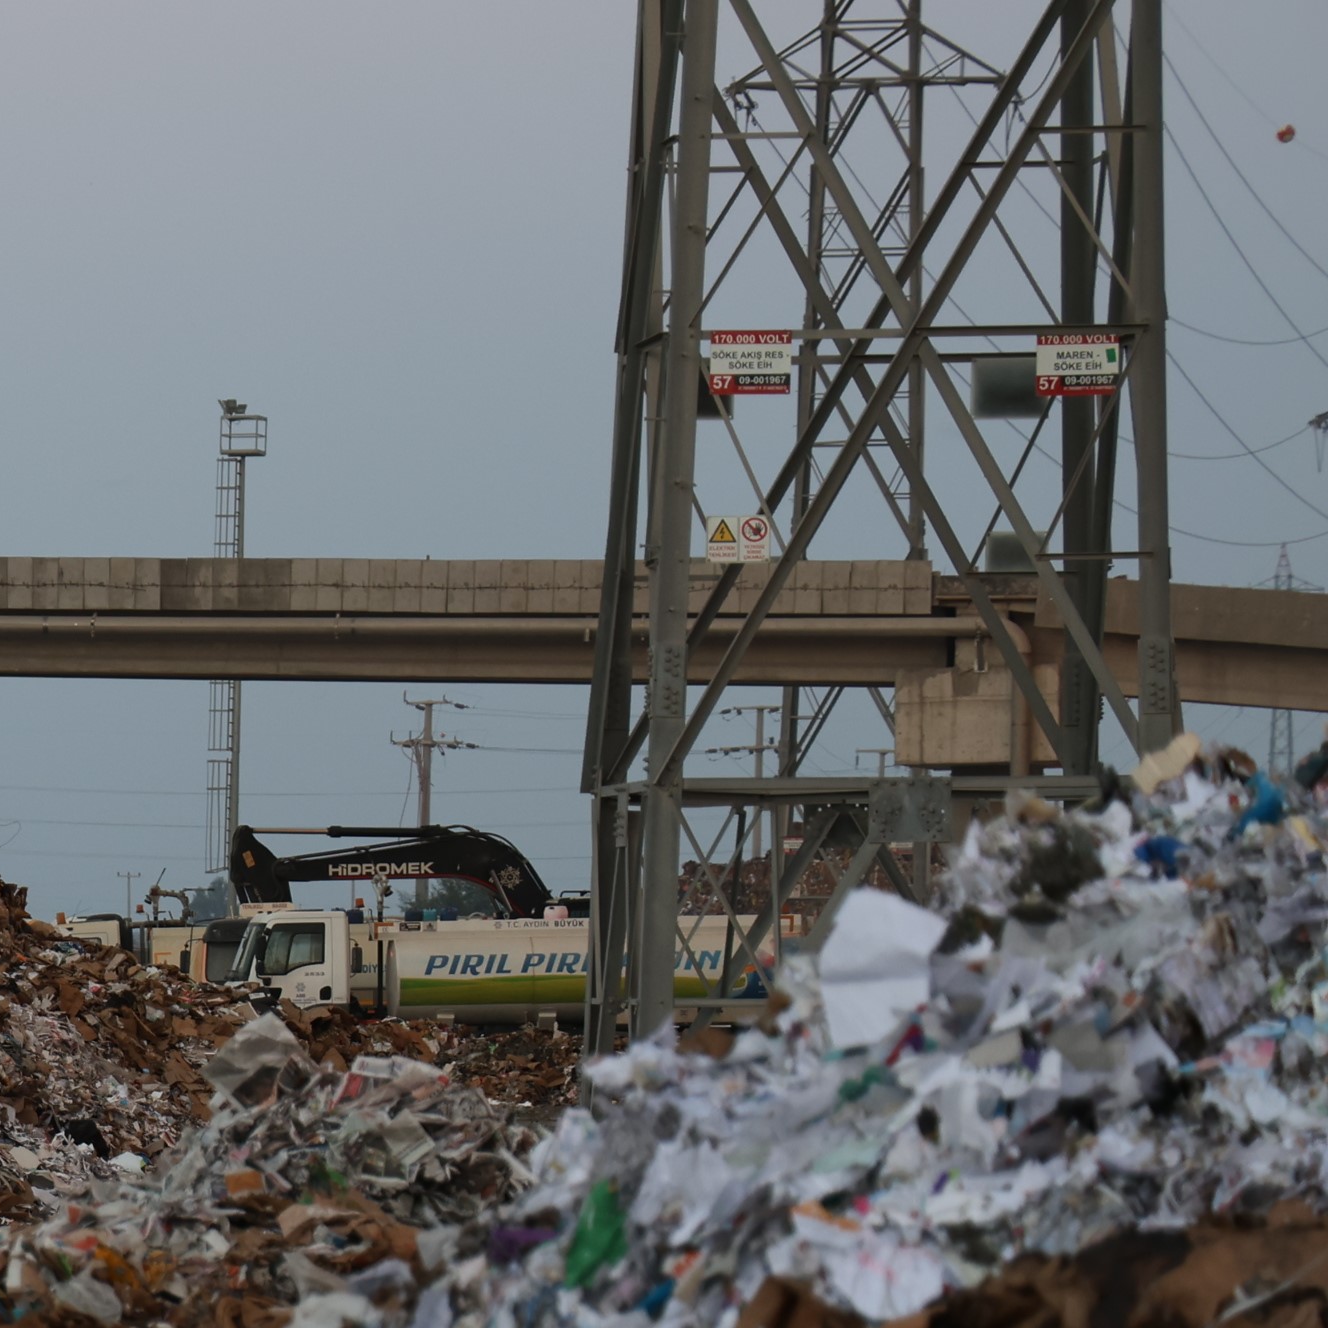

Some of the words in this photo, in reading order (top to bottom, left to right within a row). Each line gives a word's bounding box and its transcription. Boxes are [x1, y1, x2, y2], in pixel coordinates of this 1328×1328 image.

[714, 334, 756, 344] 170.000
[759, 334, 789, 344] VOLT
[1041, 335, 1083, 344] 170.000
[1086, 334, 1116, 343] VOLT
[712, 351, 738, 359] SÖKE
[765, 351, 783, 359] RES
[1057, 351, 1093, 359] MAREN
[729, 361, 755, 369] SÖKE
[1054, 361, 1082, 371] SÖKE
[713, 376, 732, 389] 57
[739, 376, 786, 384] 09-001967
[1039, 376, 1059, 390] 57
[1065, 375, 1114, 385] 09-001967
[424, 953, 512, 976] PIRIL
